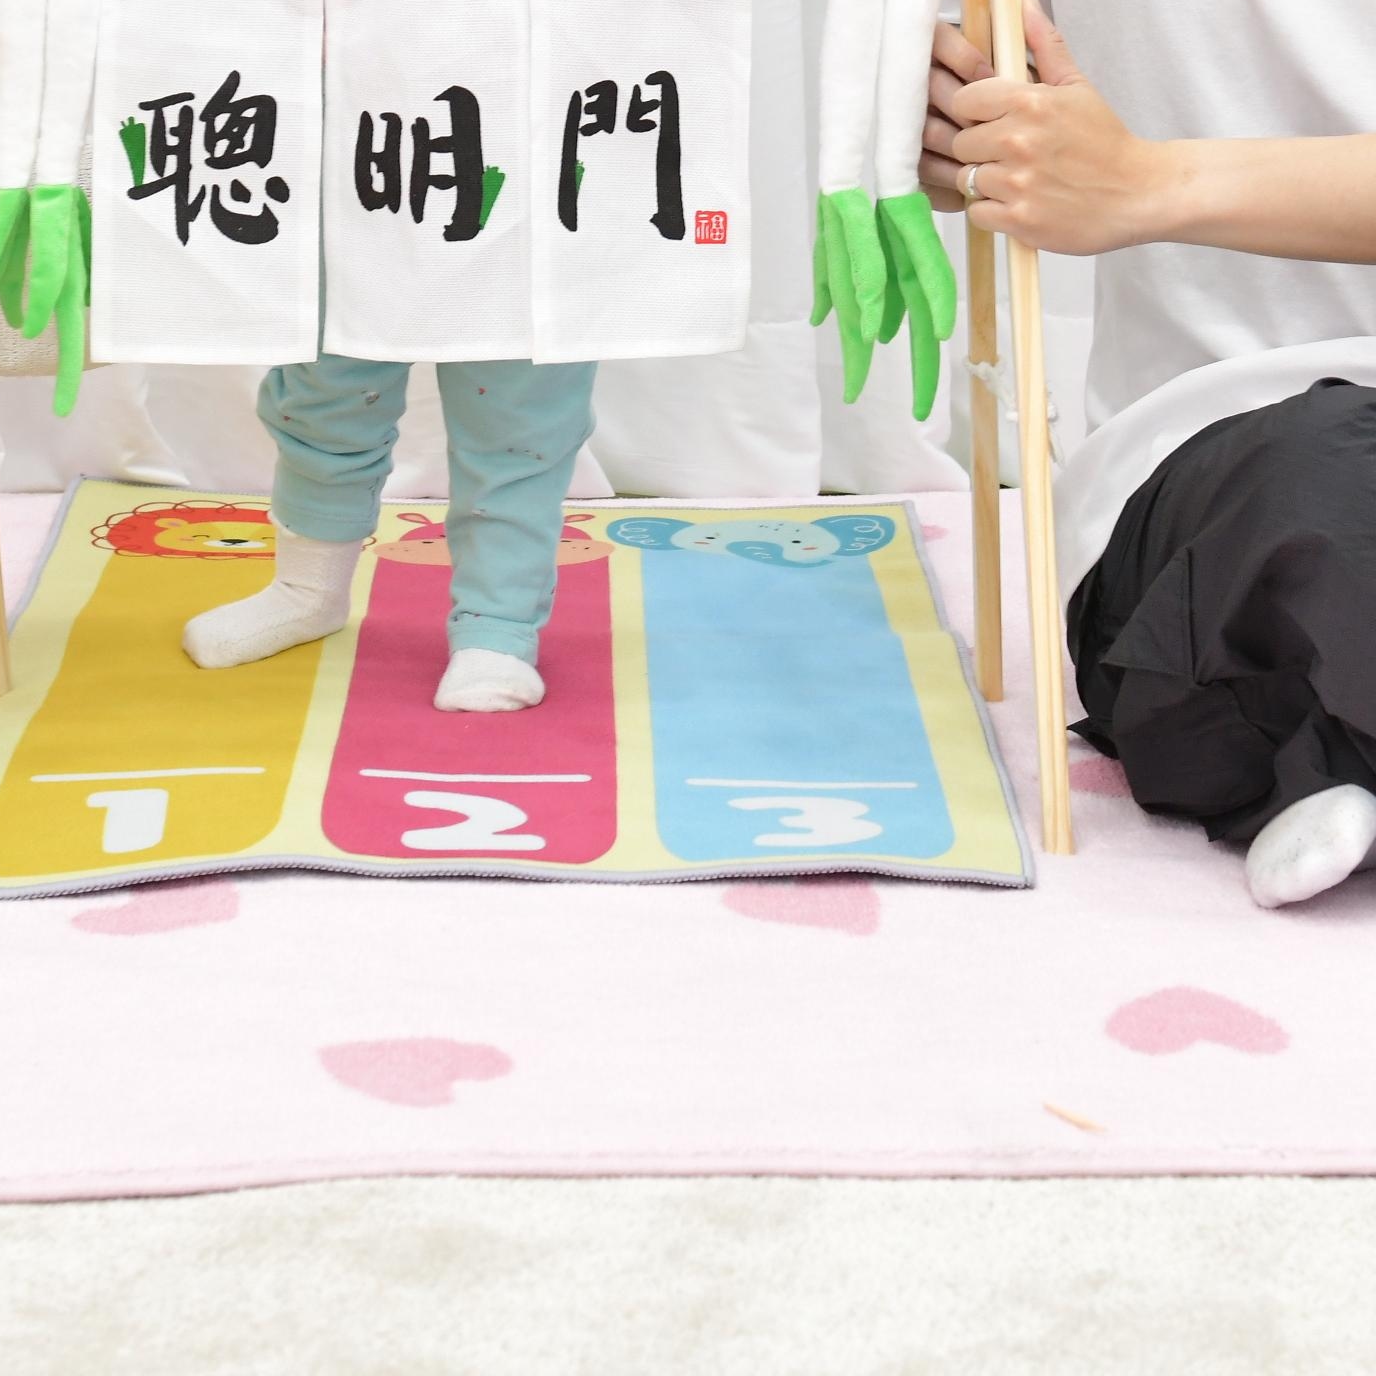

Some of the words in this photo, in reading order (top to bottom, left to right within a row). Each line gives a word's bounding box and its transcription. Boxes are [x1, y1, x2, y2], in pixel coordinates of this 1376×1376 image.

[86, 788, 169, 854] 1
[400, 789, 546, 851] 2
[727, 796, 883, 847] 3
